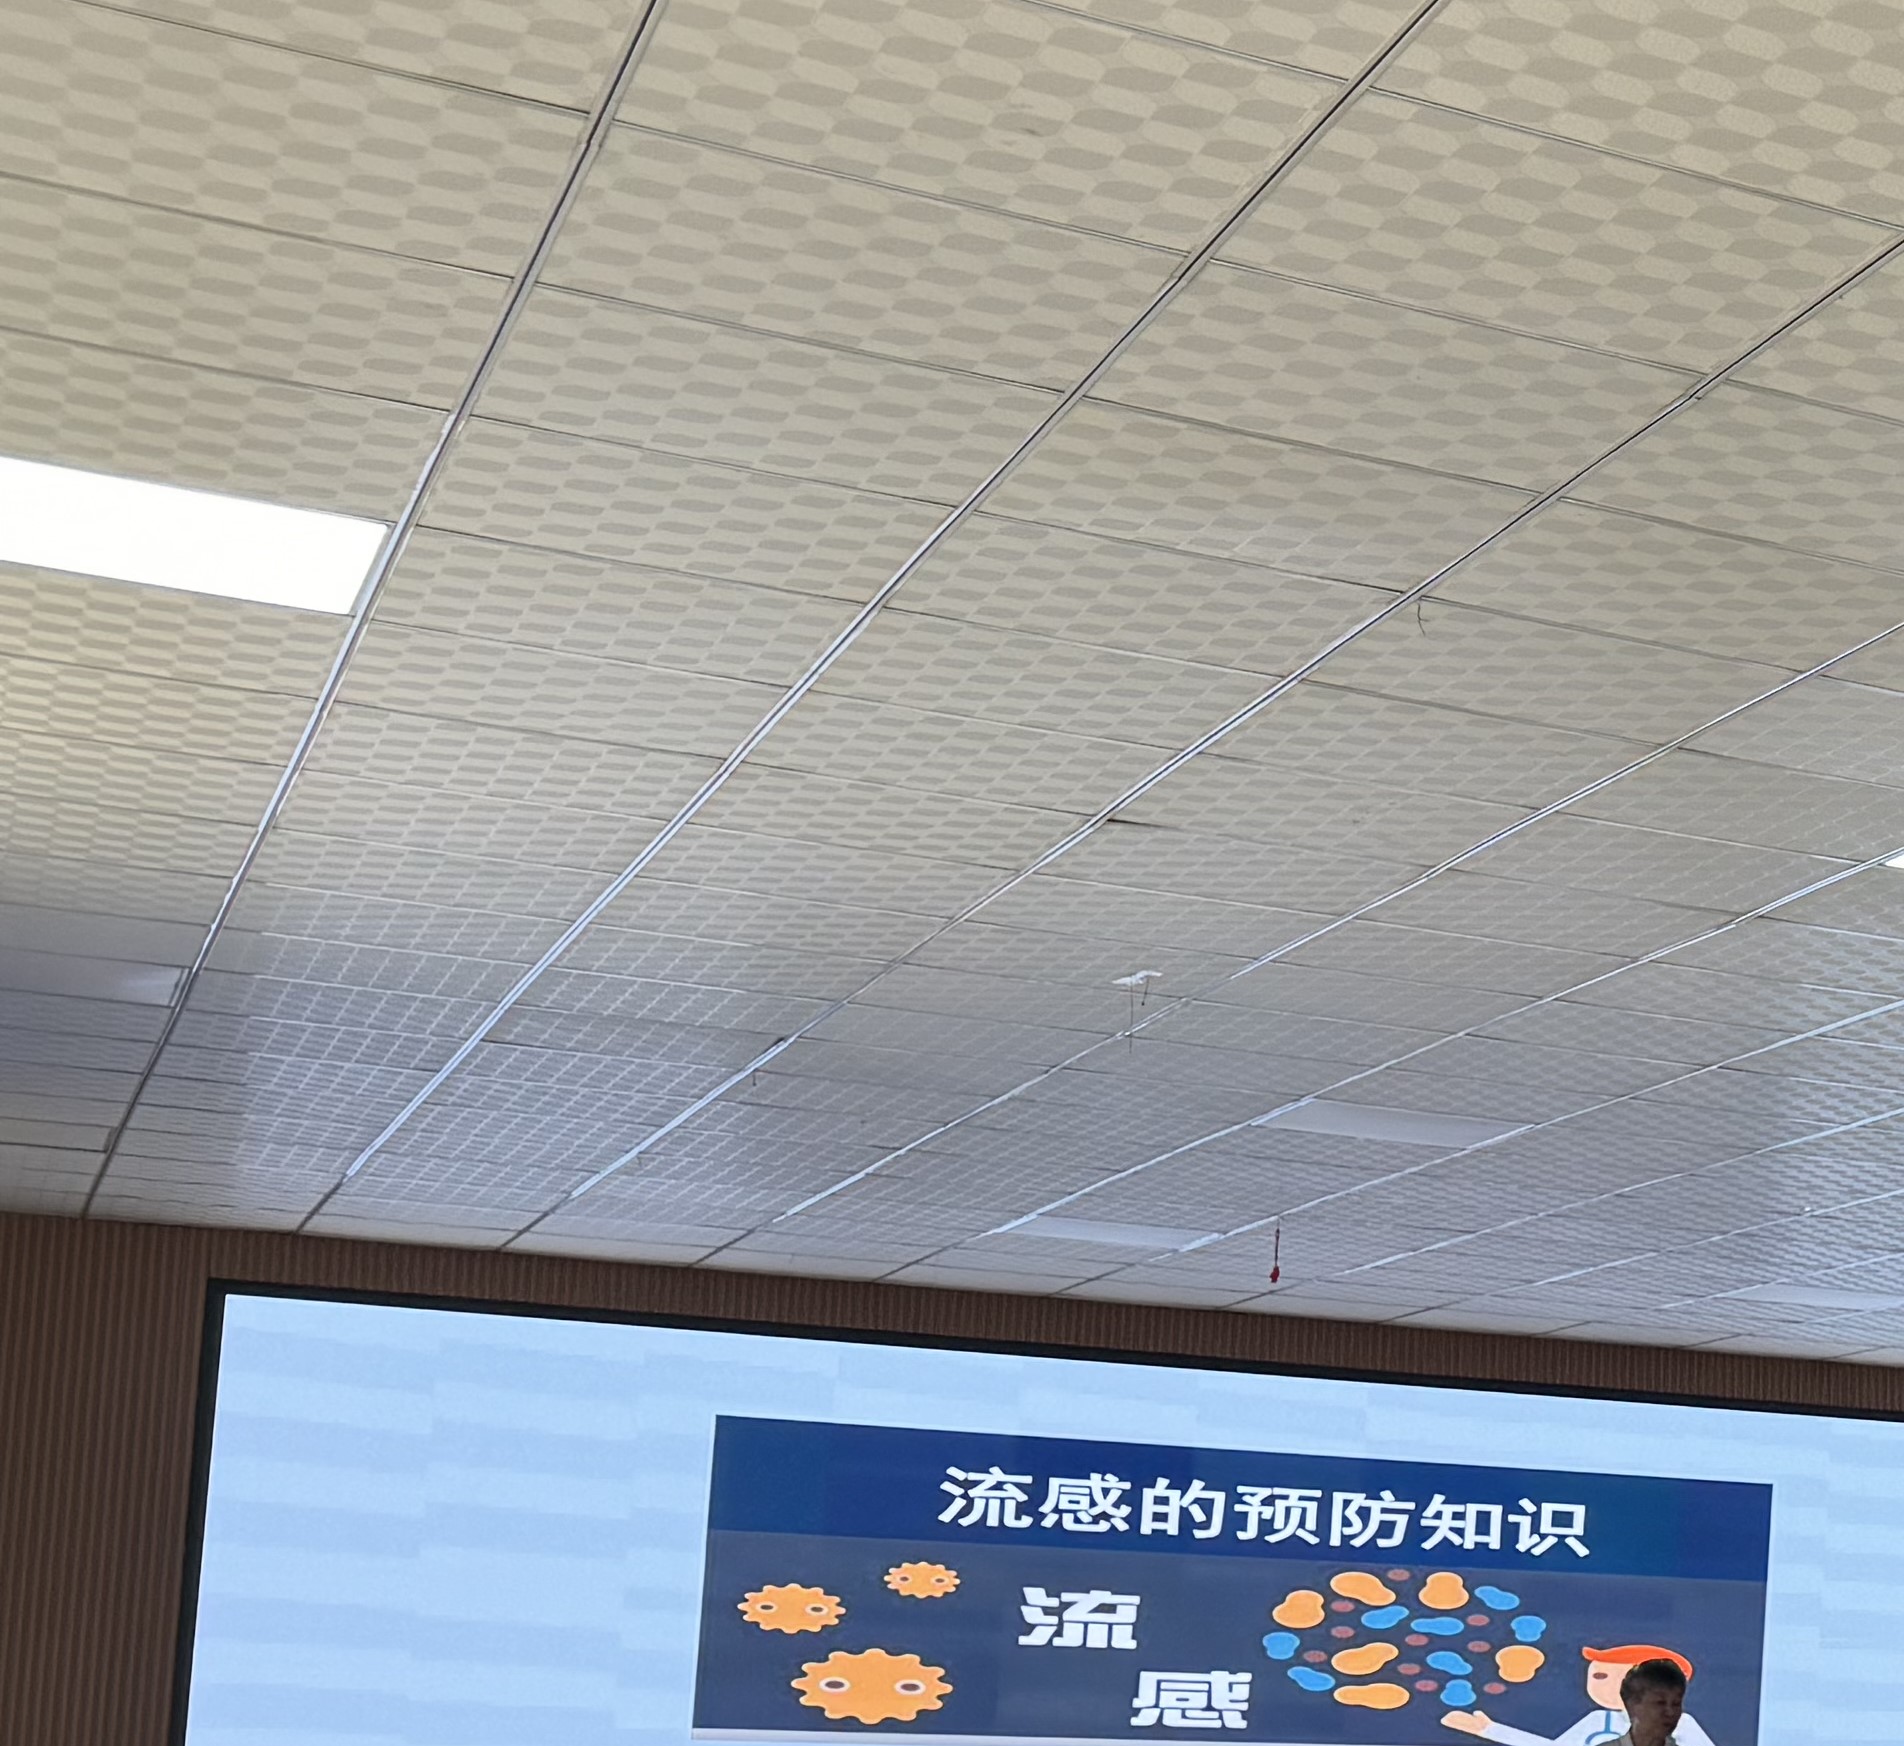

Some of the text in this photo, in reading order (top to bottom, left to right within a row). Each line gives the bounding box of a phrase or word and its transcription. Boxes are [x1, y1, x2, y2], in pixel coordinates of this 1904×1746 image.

[937, 1465, 1590, 1559] 流感的预防知识
[1018, 1586, 1141, 1650] 流
[1130, 1670, 1252, 1729] 感
